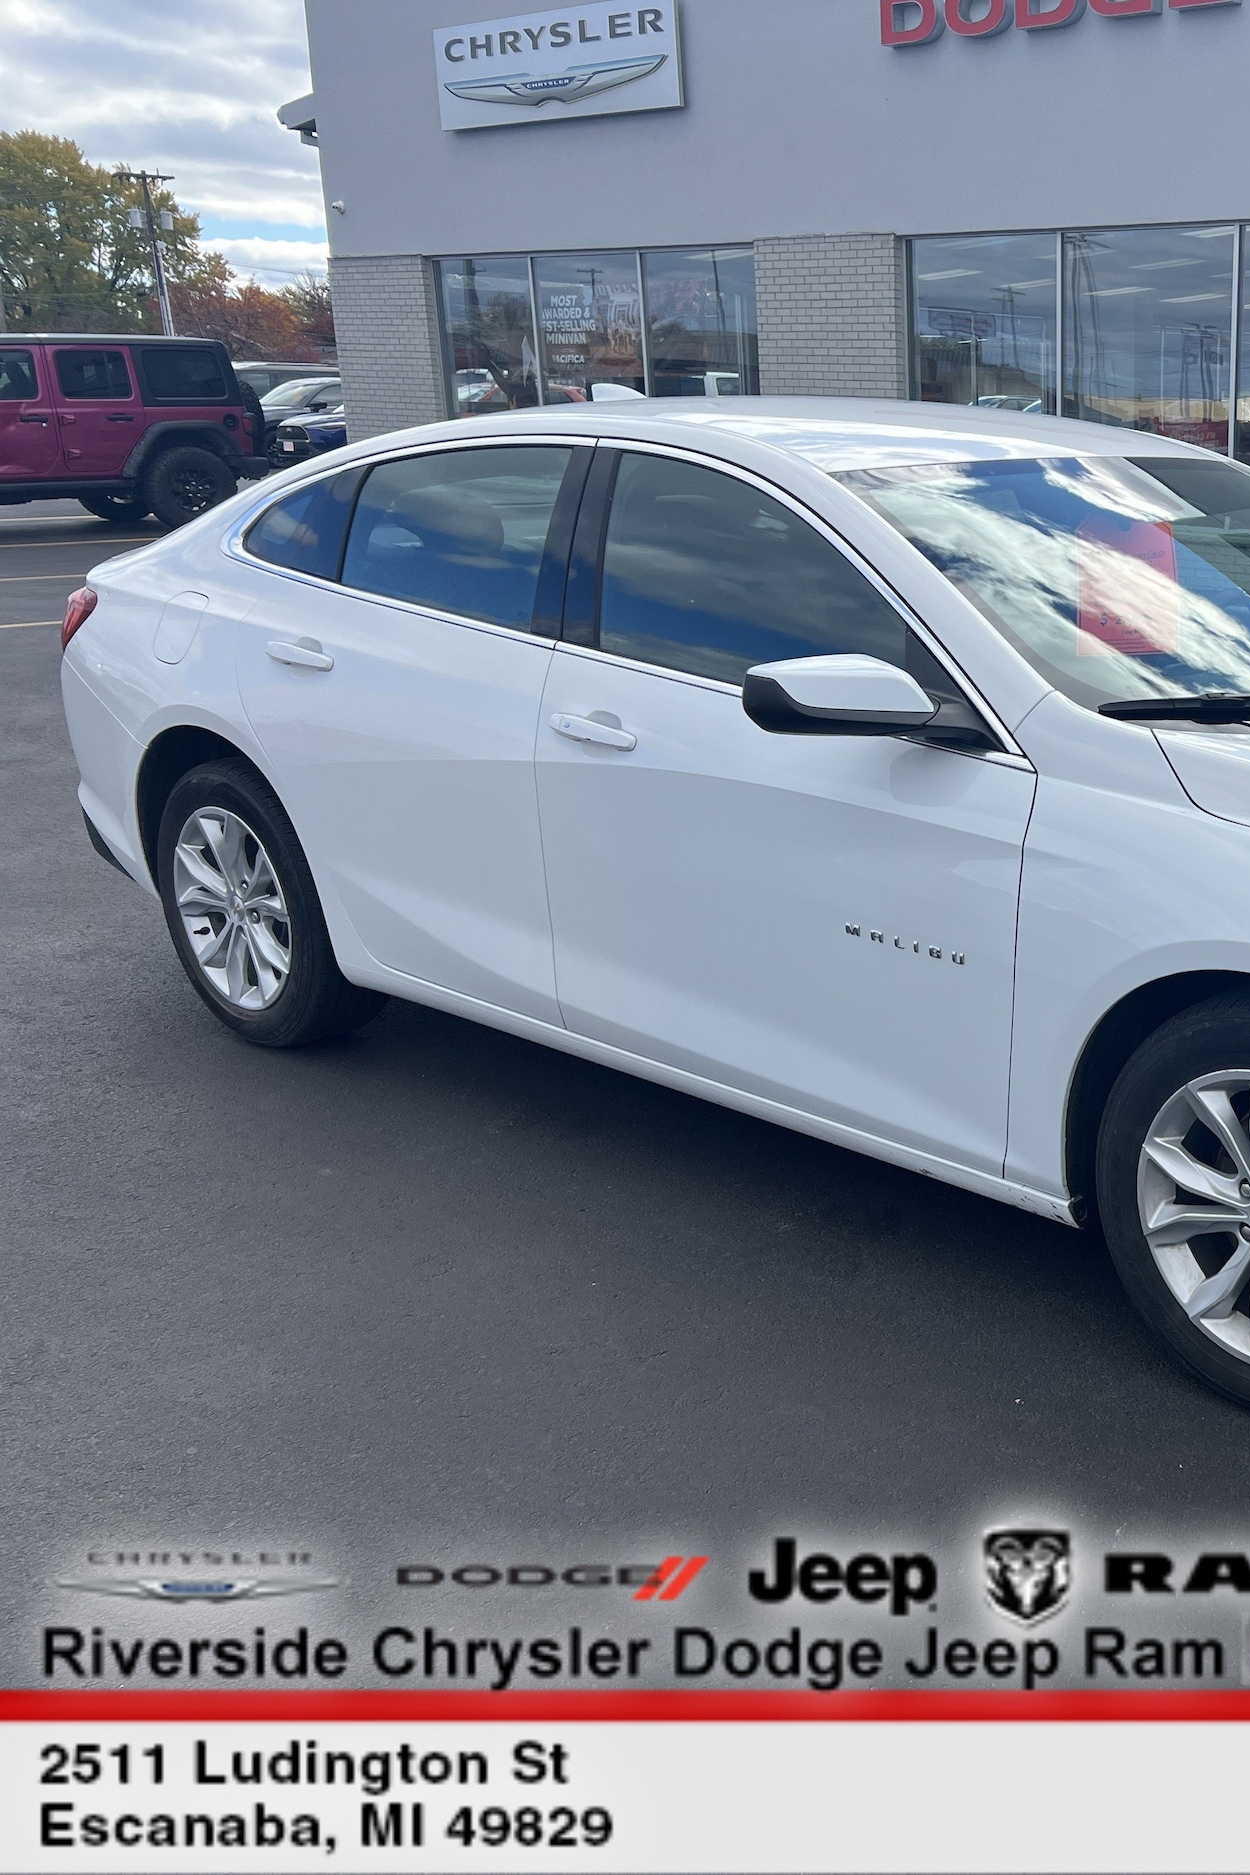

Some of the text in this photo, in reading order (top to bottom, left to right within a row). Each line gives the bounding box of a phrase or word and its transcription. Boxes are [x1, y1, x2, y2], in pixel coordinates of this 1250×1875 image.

[881, 0, 1235, 47] DOD
[444, 8, 665, 62] CHRYSLER
[526, 79, 570, 89] CHRYSLER
[550, 295, 578, 306] MOST
[584, 306, 591, 318] &
[542, 319, 596, 331] EST-SELLING
[546, 332, 587, 344] MINIVAN
[845, 922, 965, 965] MALIBU
